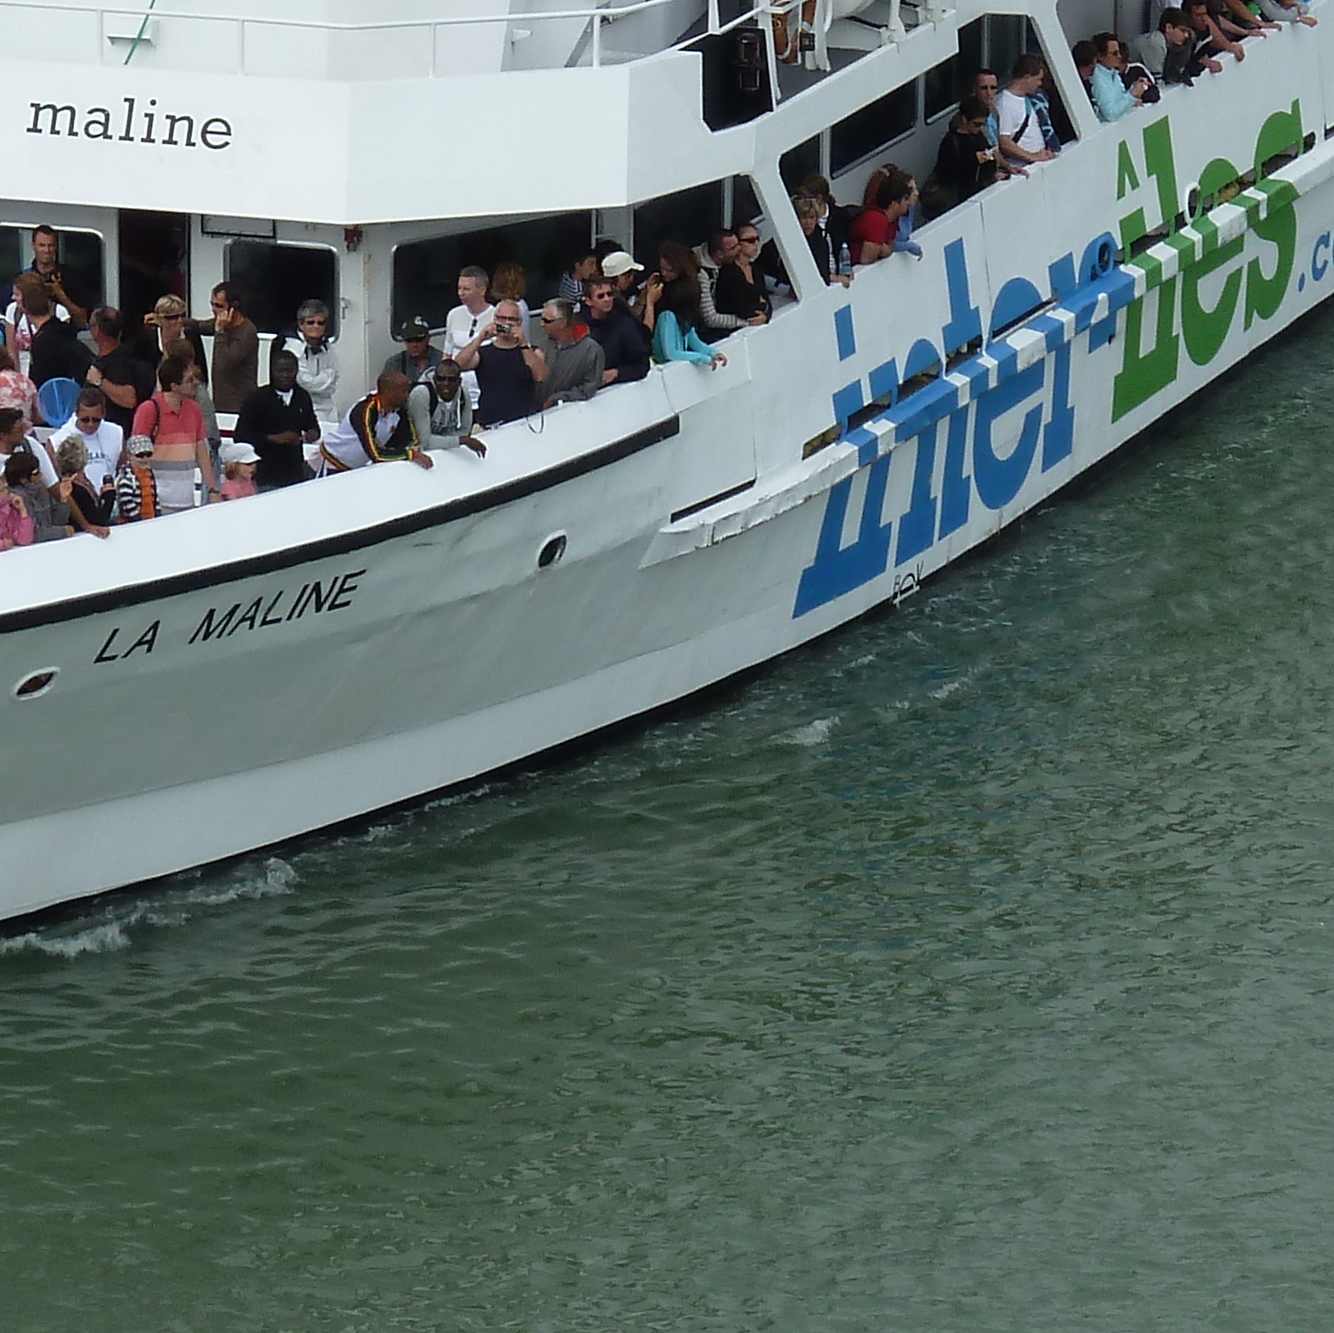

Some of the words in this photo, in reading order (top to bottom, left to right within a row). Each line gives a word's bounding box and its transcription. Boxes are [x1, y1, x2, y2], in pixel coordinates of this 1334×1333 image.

[26, 97, 233, 150] maline
[93, 619, 161, 664] LA
[188, 568, 367, 645] MALINE
